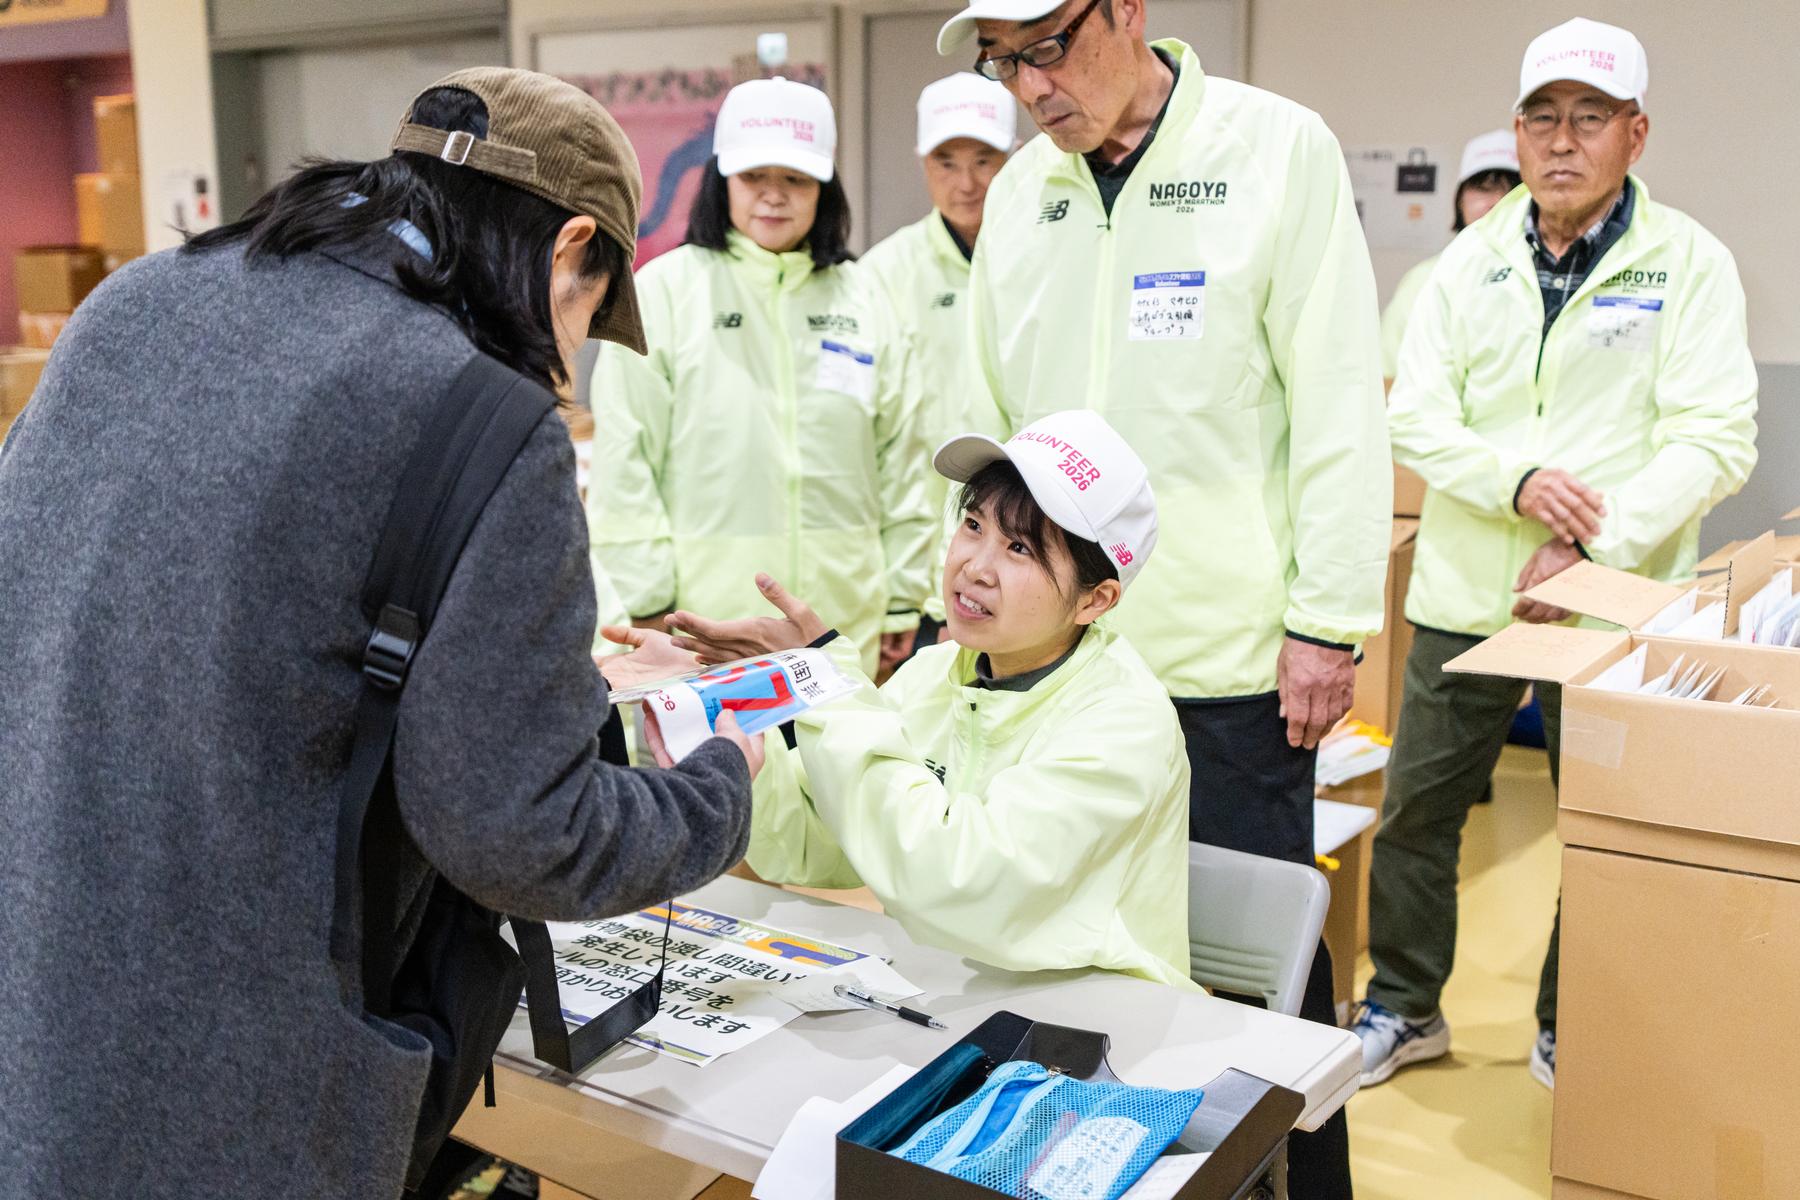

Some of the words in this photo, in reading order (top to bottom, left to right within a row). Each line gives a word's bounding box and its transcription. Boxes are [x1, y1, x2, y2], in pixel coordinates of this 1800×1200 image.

[1150, 182, 1228, 200] NAGOYA
[1603, 269, 1667, 284] AGOYA
[1057, 459, 1091, 491] 2026
[675, 911, 770, 942] NAGOYA
